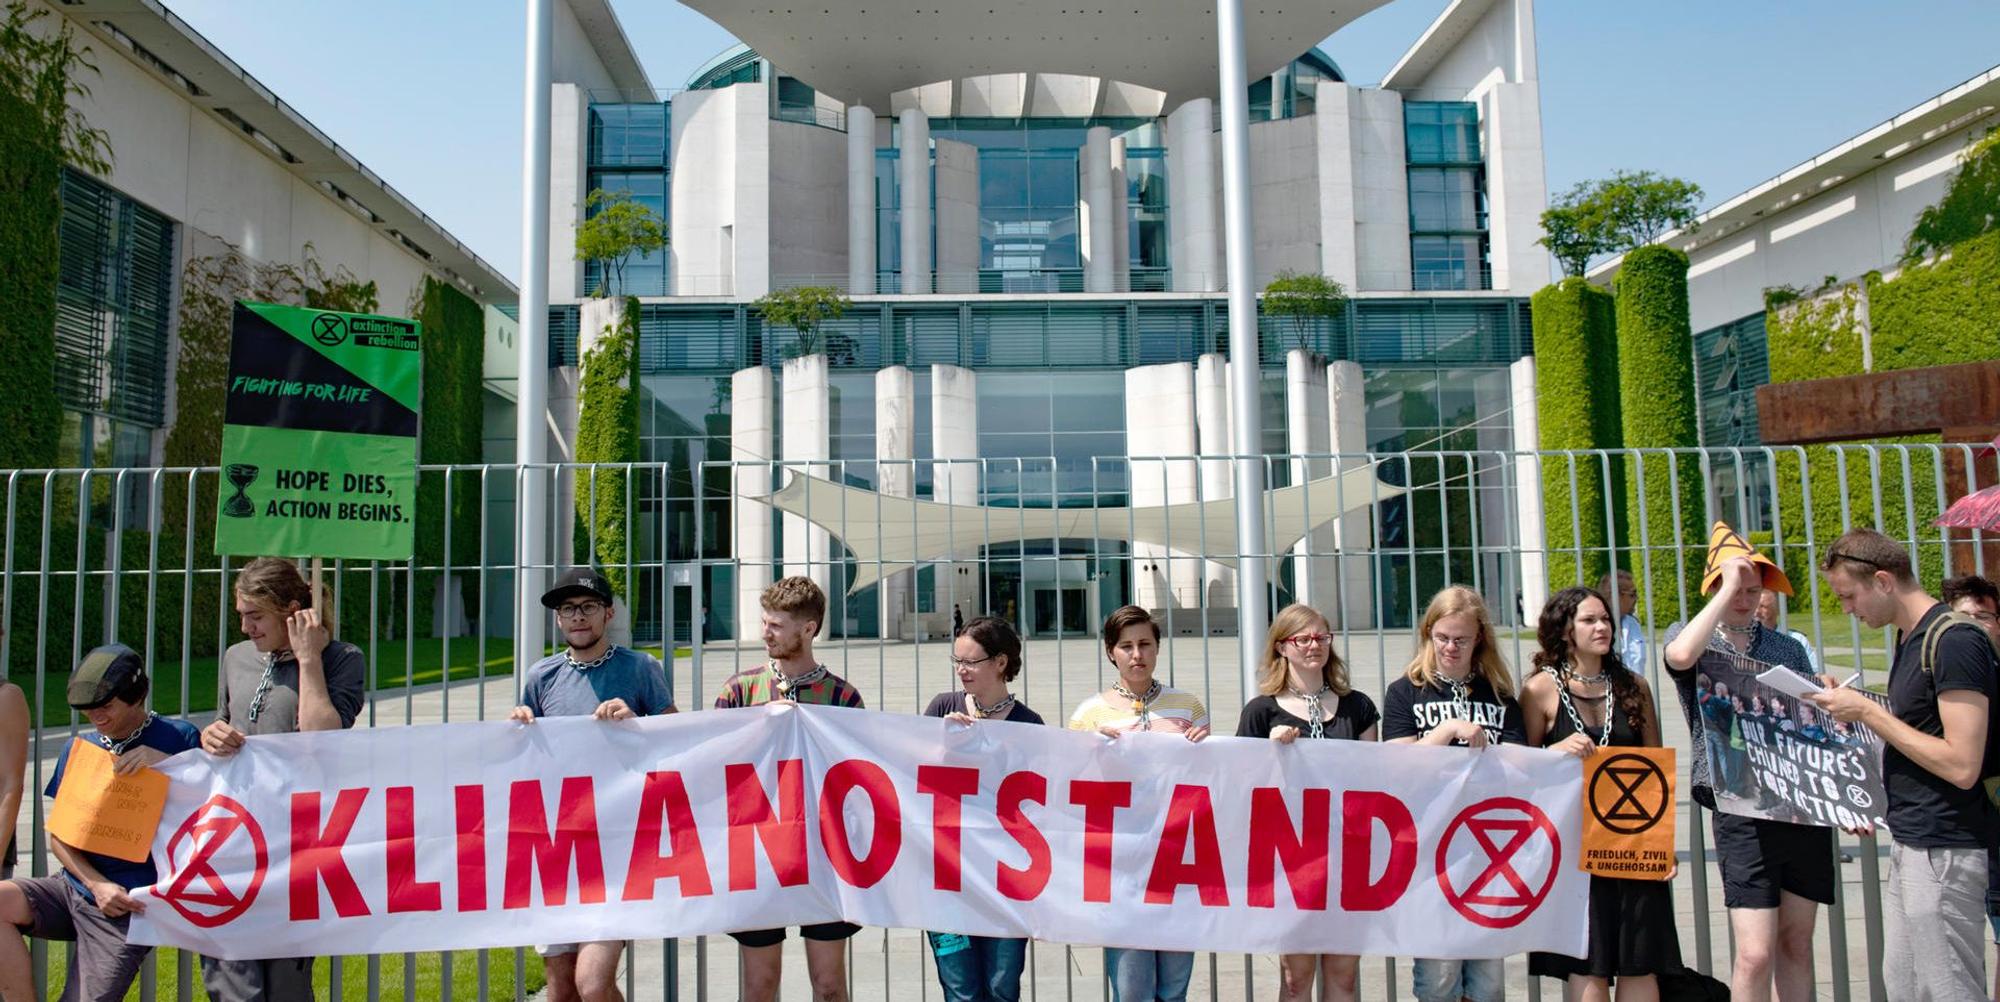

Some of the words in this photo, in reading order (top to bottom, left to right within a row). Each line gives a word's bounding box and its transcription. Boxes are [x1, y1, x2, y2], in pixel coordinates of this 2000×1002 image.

[352, 319, 407, 333] extinction
[368, 335, 418, 350] rebellion
[230, 376, 303, 398] FIGHTING
[304, 383, 336, 402] FOR
[338, 384, 372, 404] LIFE
[276, 469, 330, 492] HOPE
[343, 473, 393, 499] DIES,
[265, 499, 331, 520] ACTION
[337, 502, 410, 524] BEGINS.
[1804, 769, 1840, 801] TO
[289, 759, 1418, 920] KLIMANOTSTAND
[1585, 861, 1593, 870] &
[1597, 862, 1667, 873] UNGEHORSAM
[1587, 849, 1641, 862] FRIEDLICH,
[1642, 850, 1668, 861] ZIVIL
